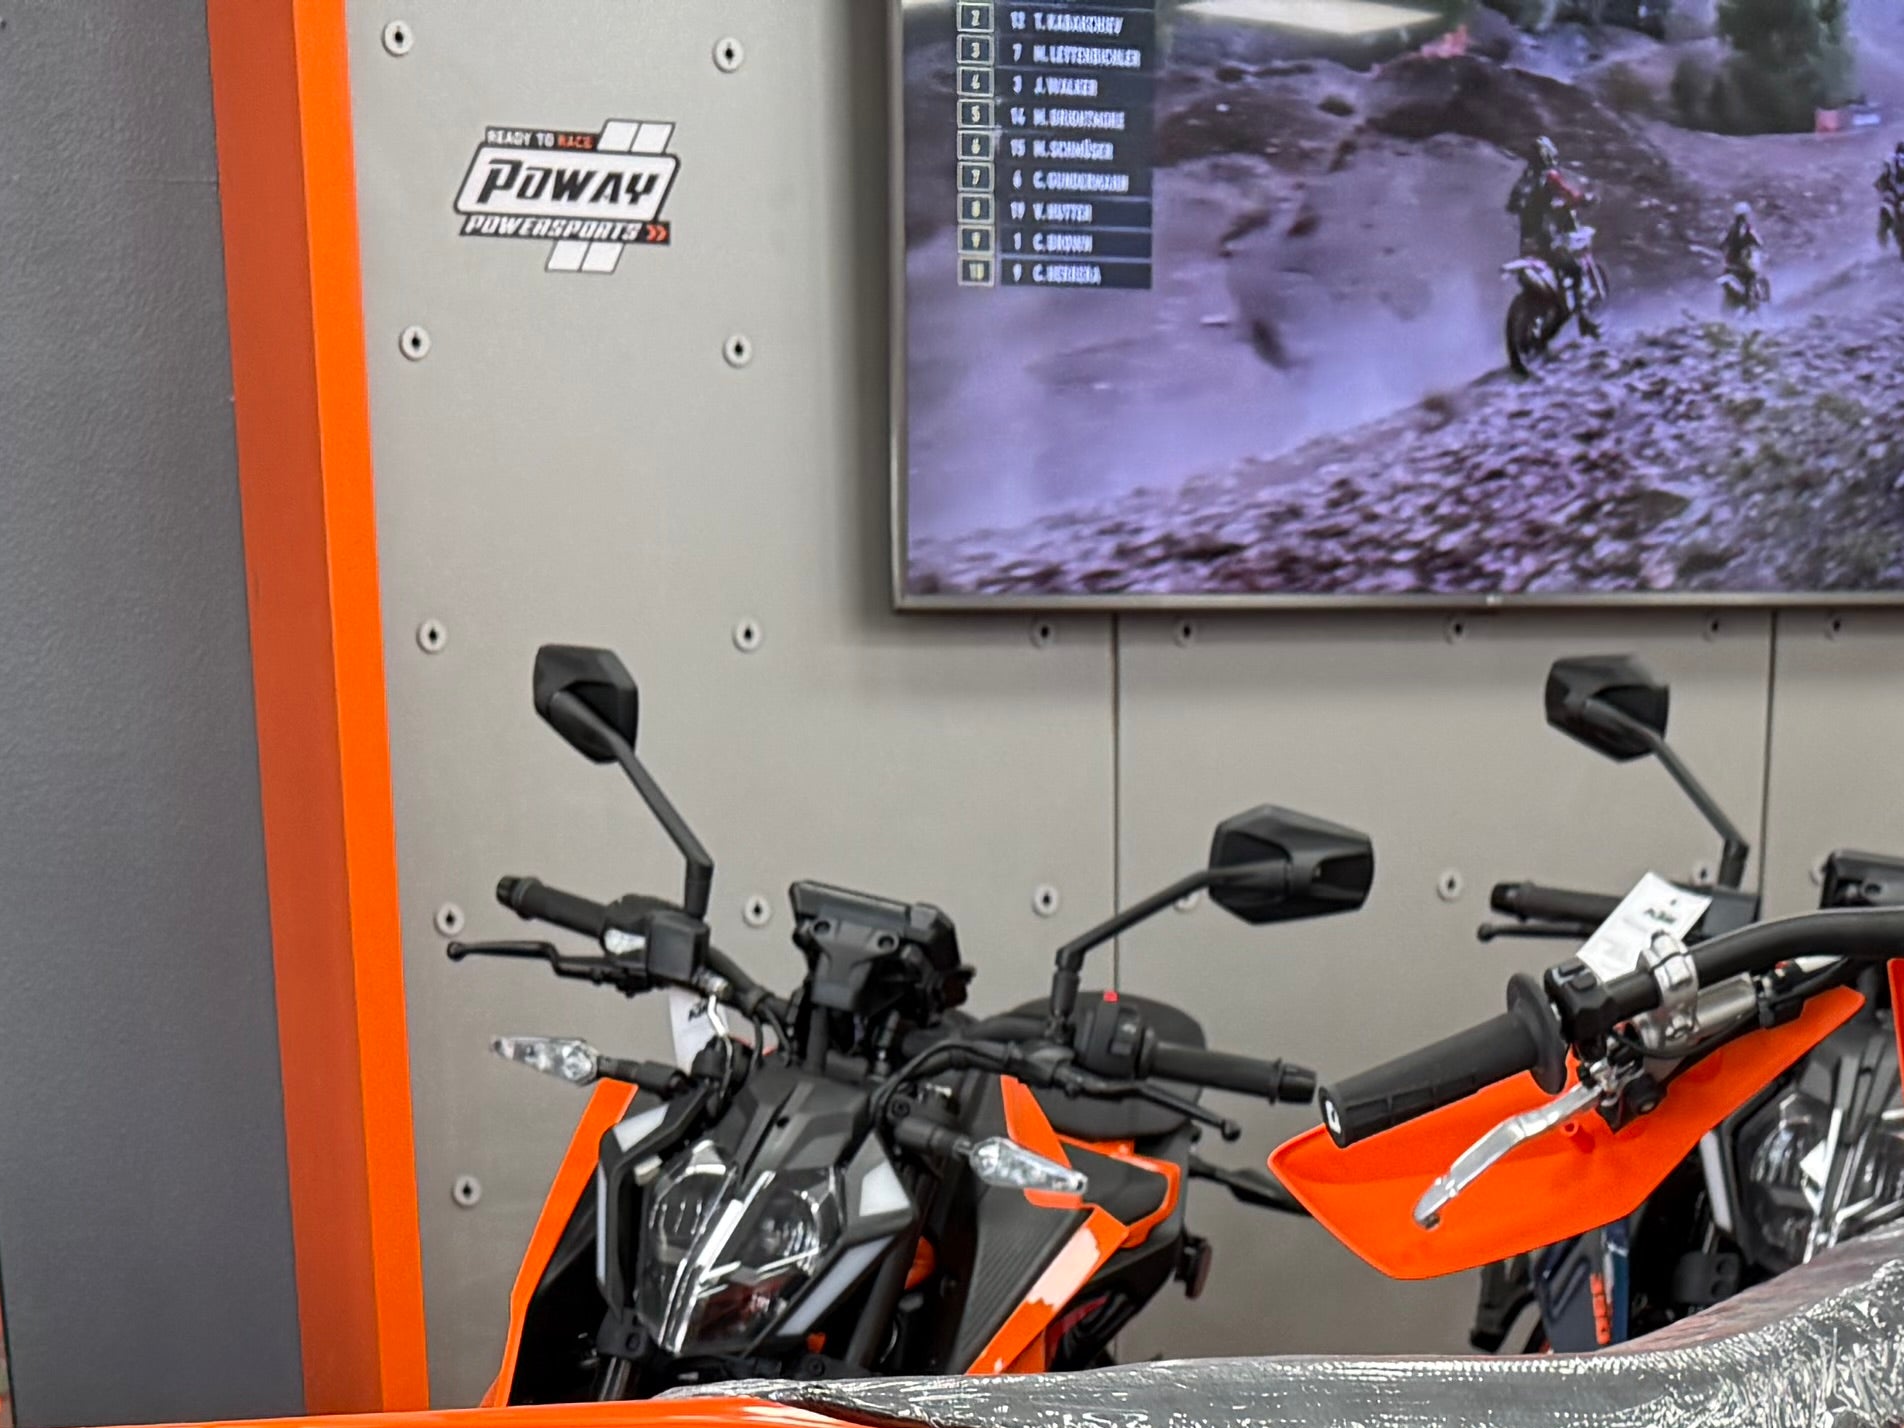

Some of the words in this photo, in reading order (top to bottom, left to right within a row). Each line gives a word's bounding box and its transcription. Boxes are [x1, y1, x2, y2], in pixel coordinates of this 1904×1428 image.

[487, 129, 532, 147] READY
[536, 131, 555, 147] TO
[558, 134, 594, 149] RACE
[477, 158, 659, 206] POWAY
[465, 216, 643, 241] POWERSPORTS
